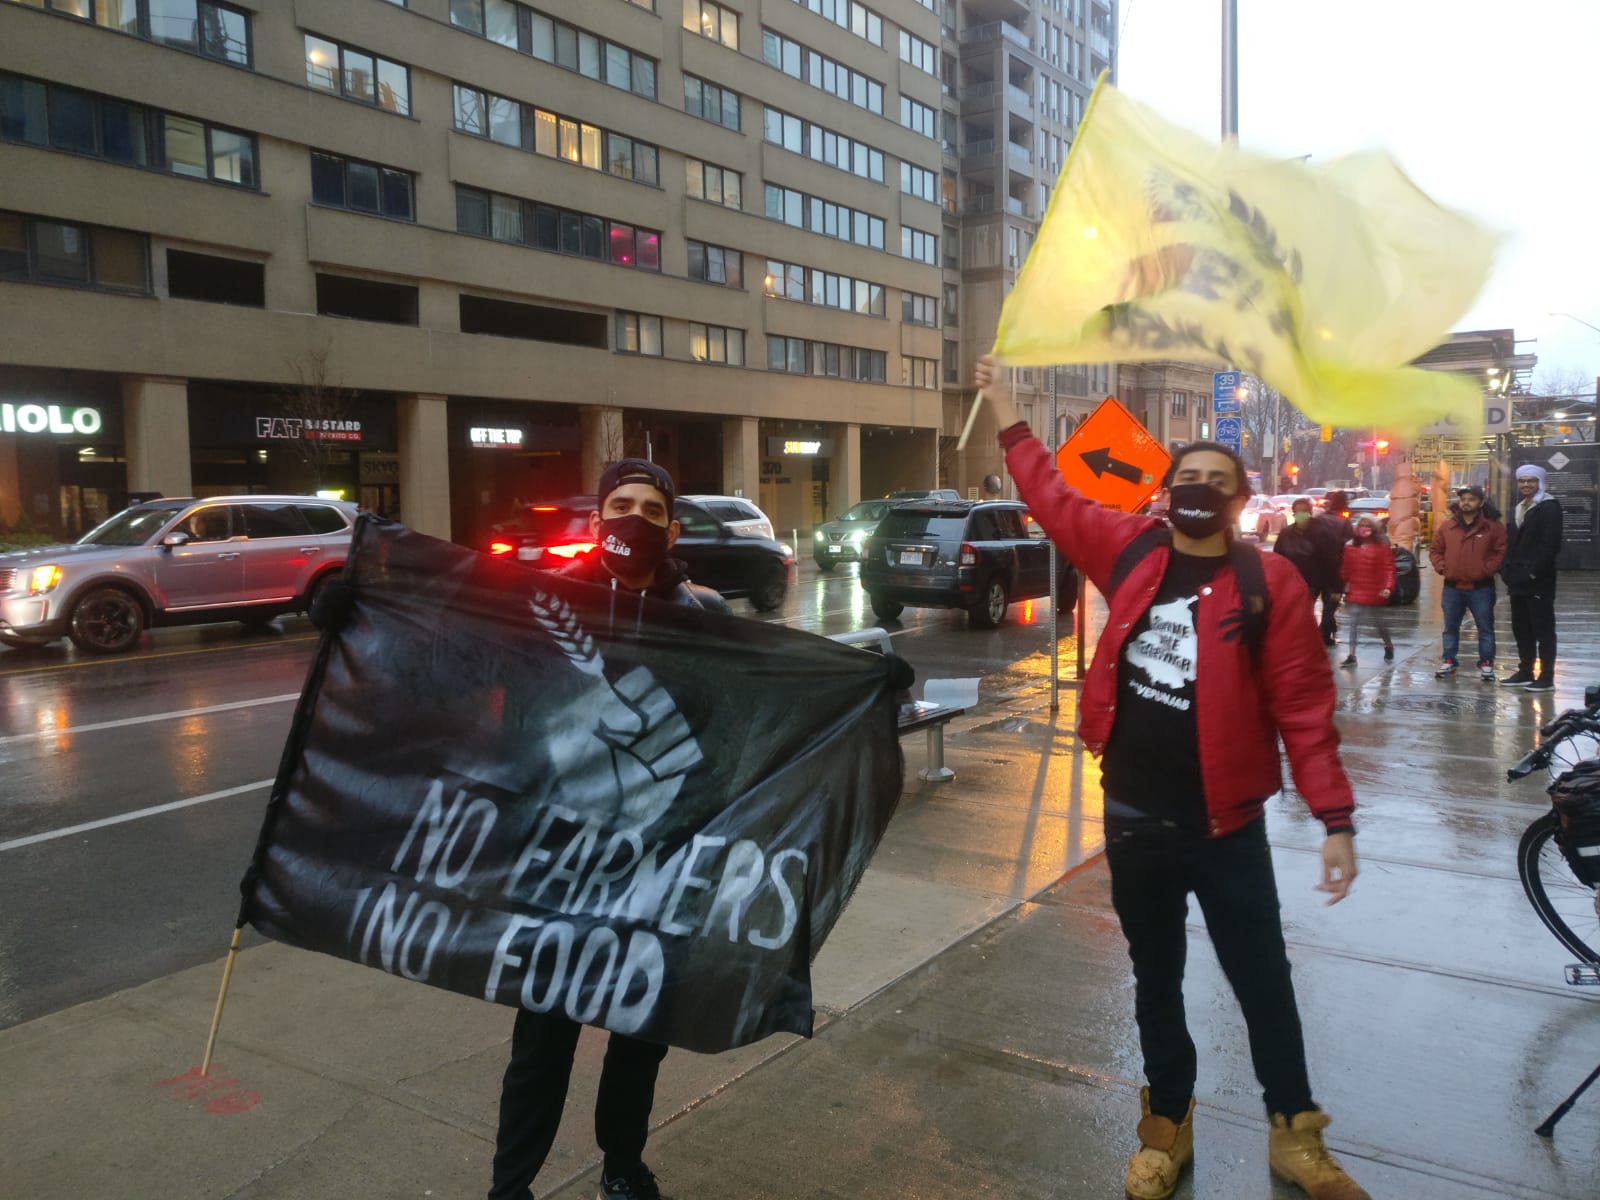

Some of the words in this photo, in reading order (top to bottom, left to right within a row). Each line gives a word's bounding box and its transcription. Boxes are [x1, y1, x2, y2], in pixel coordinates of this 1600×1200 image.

[1219, 374, 1236, 386] 39
[0, 403, 102, 434] IOLO
[256, 416, 303, 439] FAT
[470, 427, 488, 442] OFF
[487, 428, 505, 443] THE
[505, 429, 522, 444] TOP
[783, 440, 821, 454] SUBWAY
[762, 461, 782, 475] 370
[390, 779, 498, 889] NO
[503, 803, 809, 951] FARMERS
[484, 913, 666, 1035] FOOD
